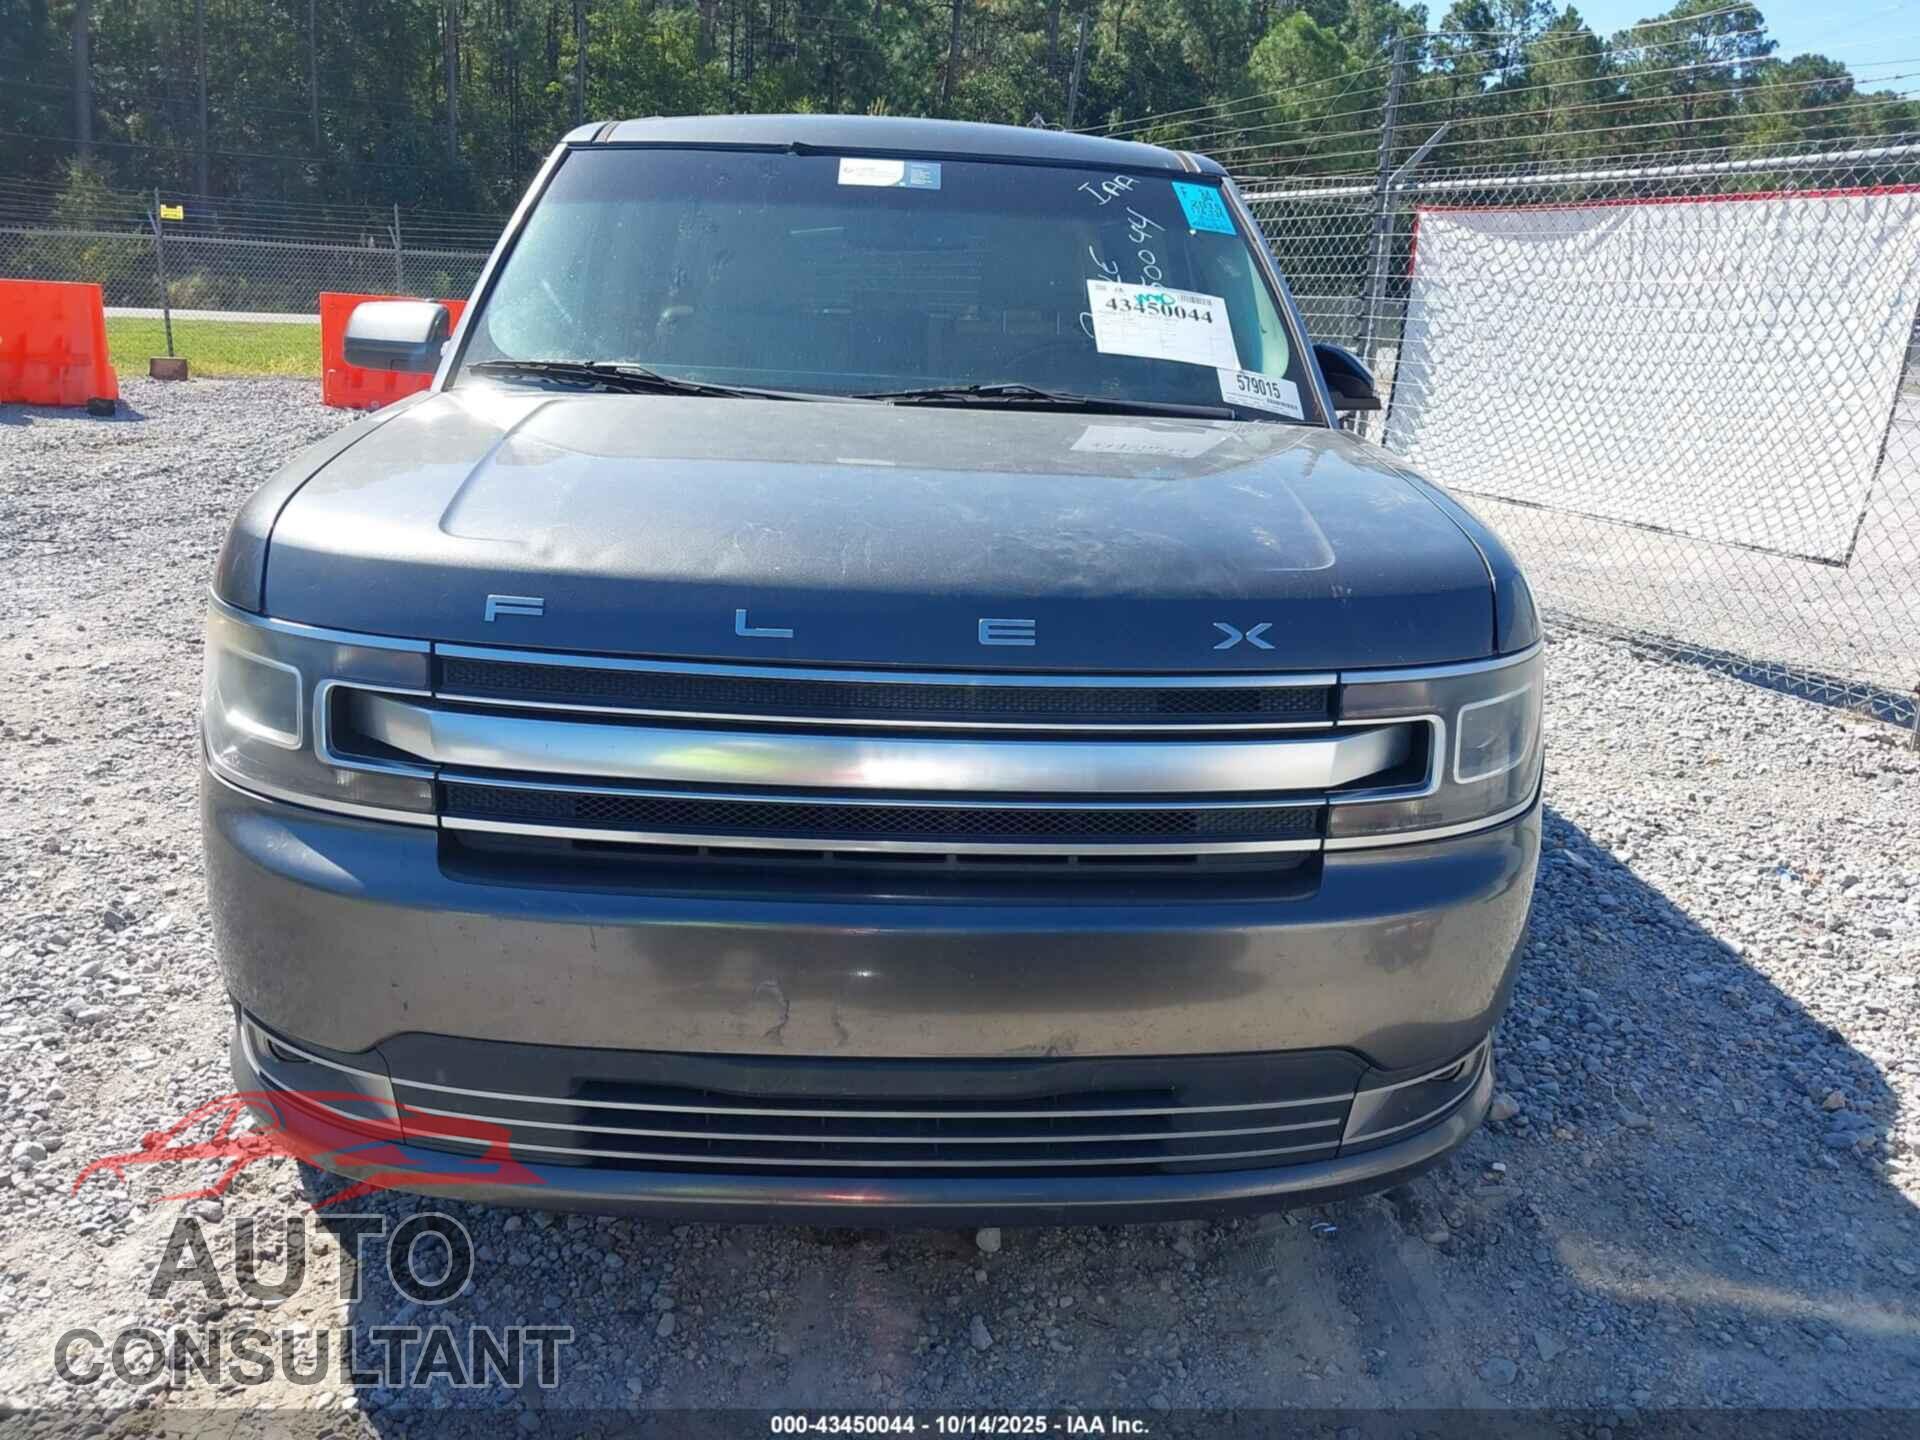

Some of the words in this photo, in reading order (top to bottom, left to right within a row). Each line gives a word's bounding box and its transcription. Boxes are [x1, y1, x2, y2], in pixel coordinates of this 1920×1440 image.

[1078, 175, 1140, 205] IAA
[1105, 297, 1213, 324] 43450044
[1236, 374, 1281, 399] 579015
